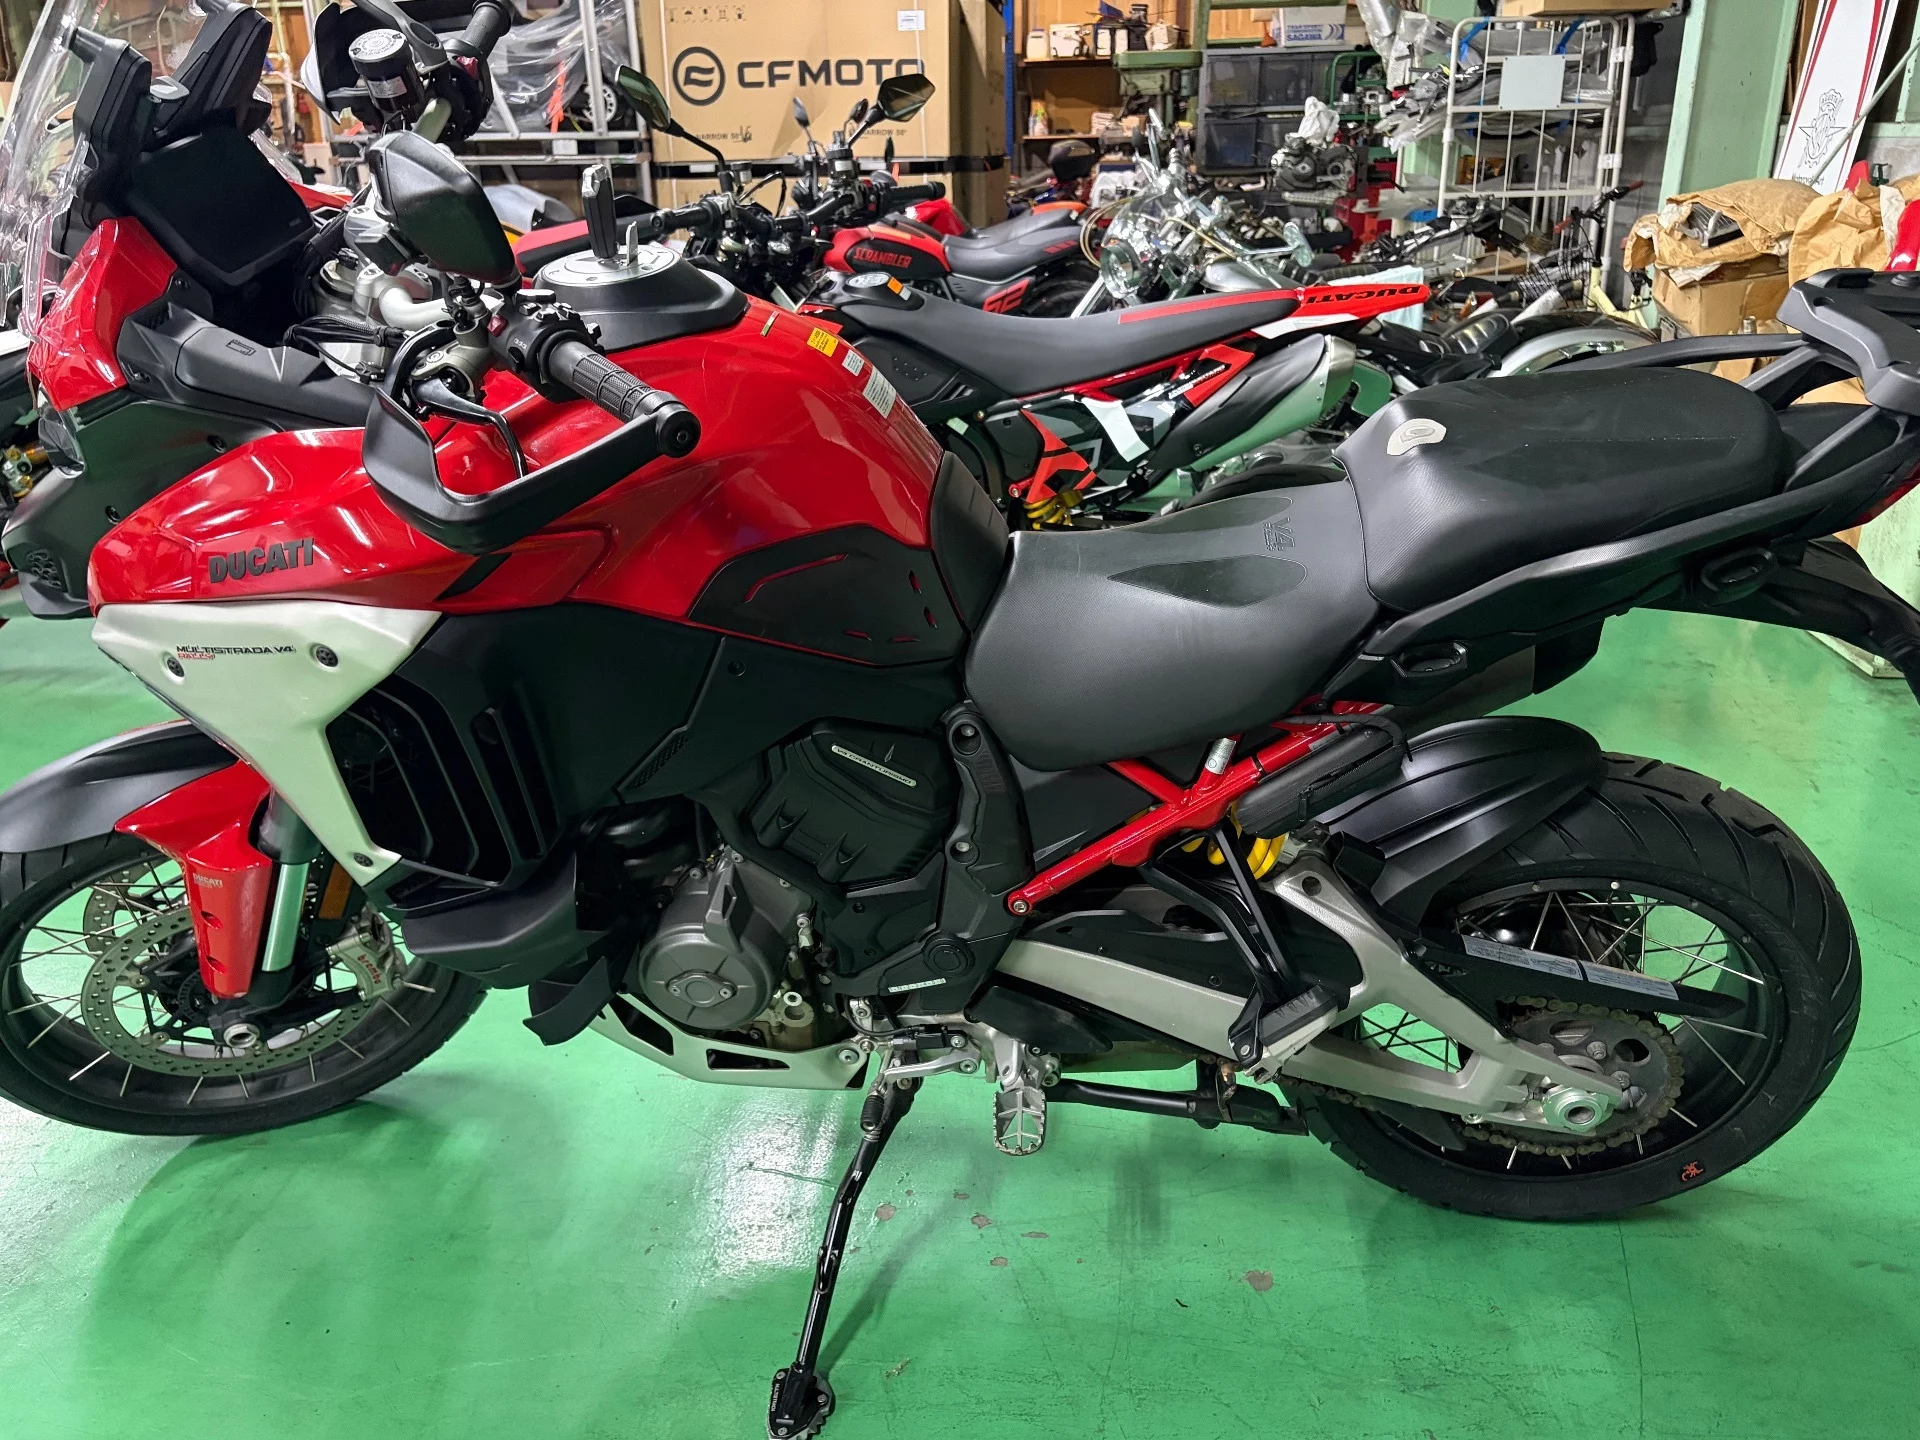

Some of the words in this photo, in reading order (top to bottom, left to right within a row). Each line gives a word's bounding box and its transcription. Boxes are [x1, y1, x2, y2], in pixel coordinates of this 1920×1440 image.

[737, 59, 924, 88] CFMOTO
[853, 247, 912, 268] SCRAMBLER
[1306, 286, 1420, 304] DUCATI
[208, 537, 314, 584] DUCATI
[176, 645, 274, 655] MULTISTRADA
[193, 872, 223, 888] DUCATI
[357, 953, 381, 984] brembo
